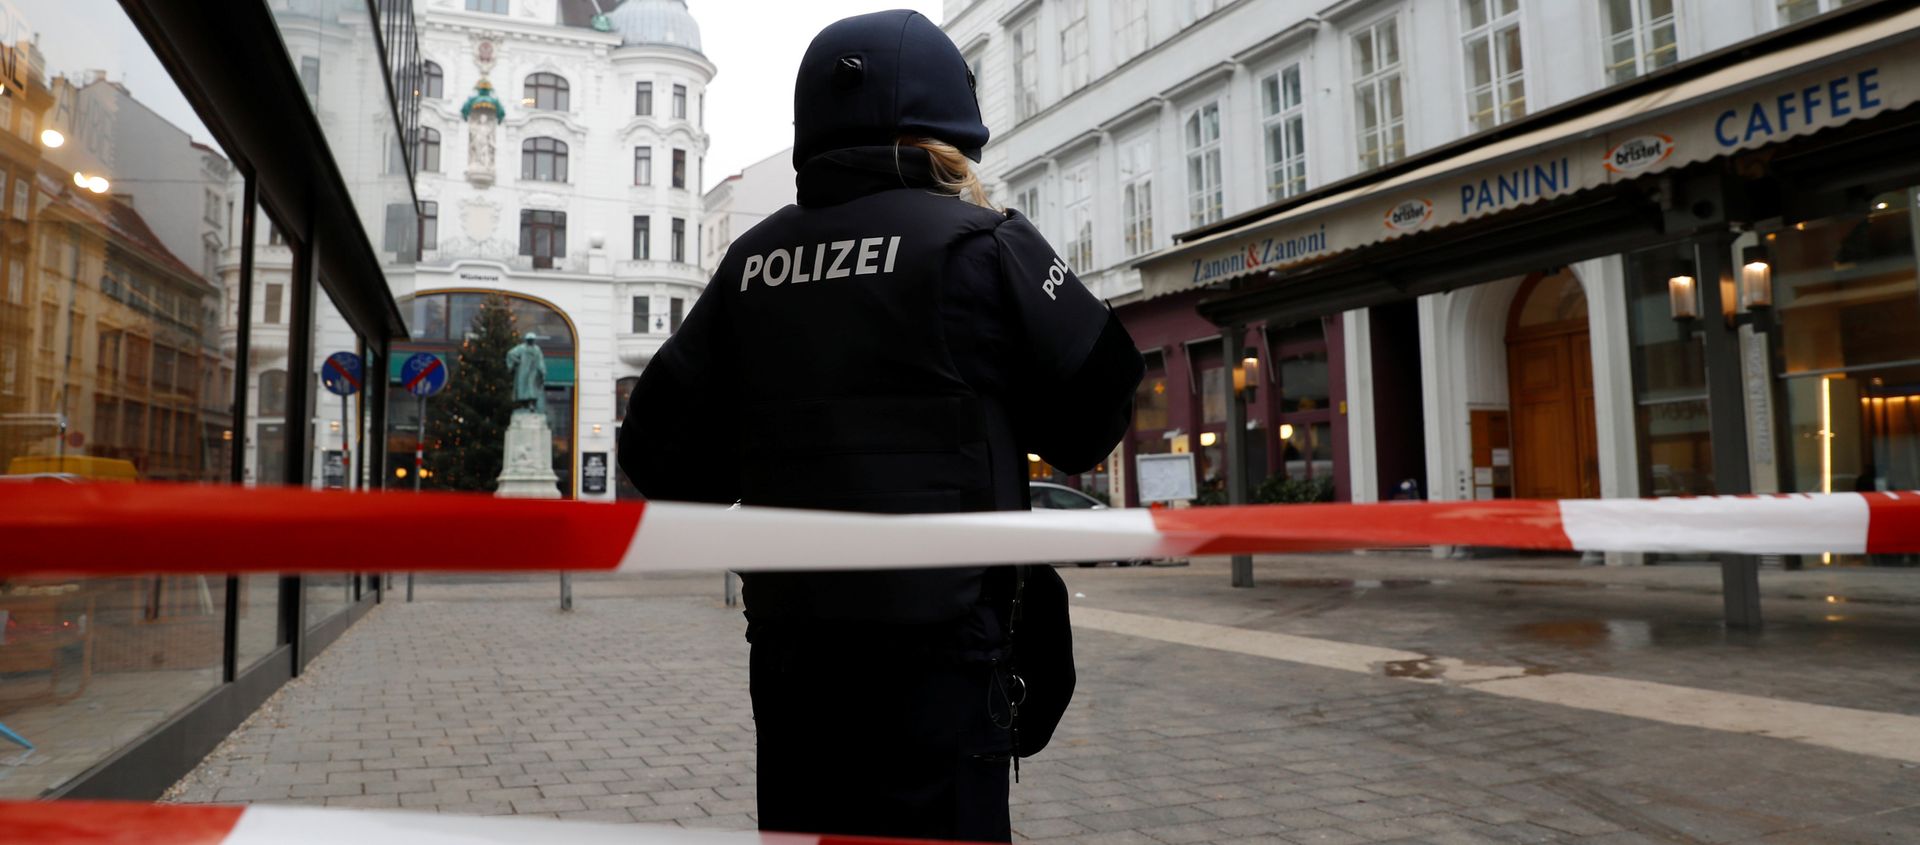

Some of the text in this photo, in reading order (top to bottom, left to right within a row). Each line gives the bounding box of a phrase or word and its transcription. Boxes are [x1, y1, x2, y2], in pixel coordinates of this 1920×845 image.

[1714, 68, 1881, 147] CAFFEE
[1461, 157, 1569, 215] PANINI
[740, 236, 901, 292] POLIZEI
[1042, 257, 1068, 301] POL
